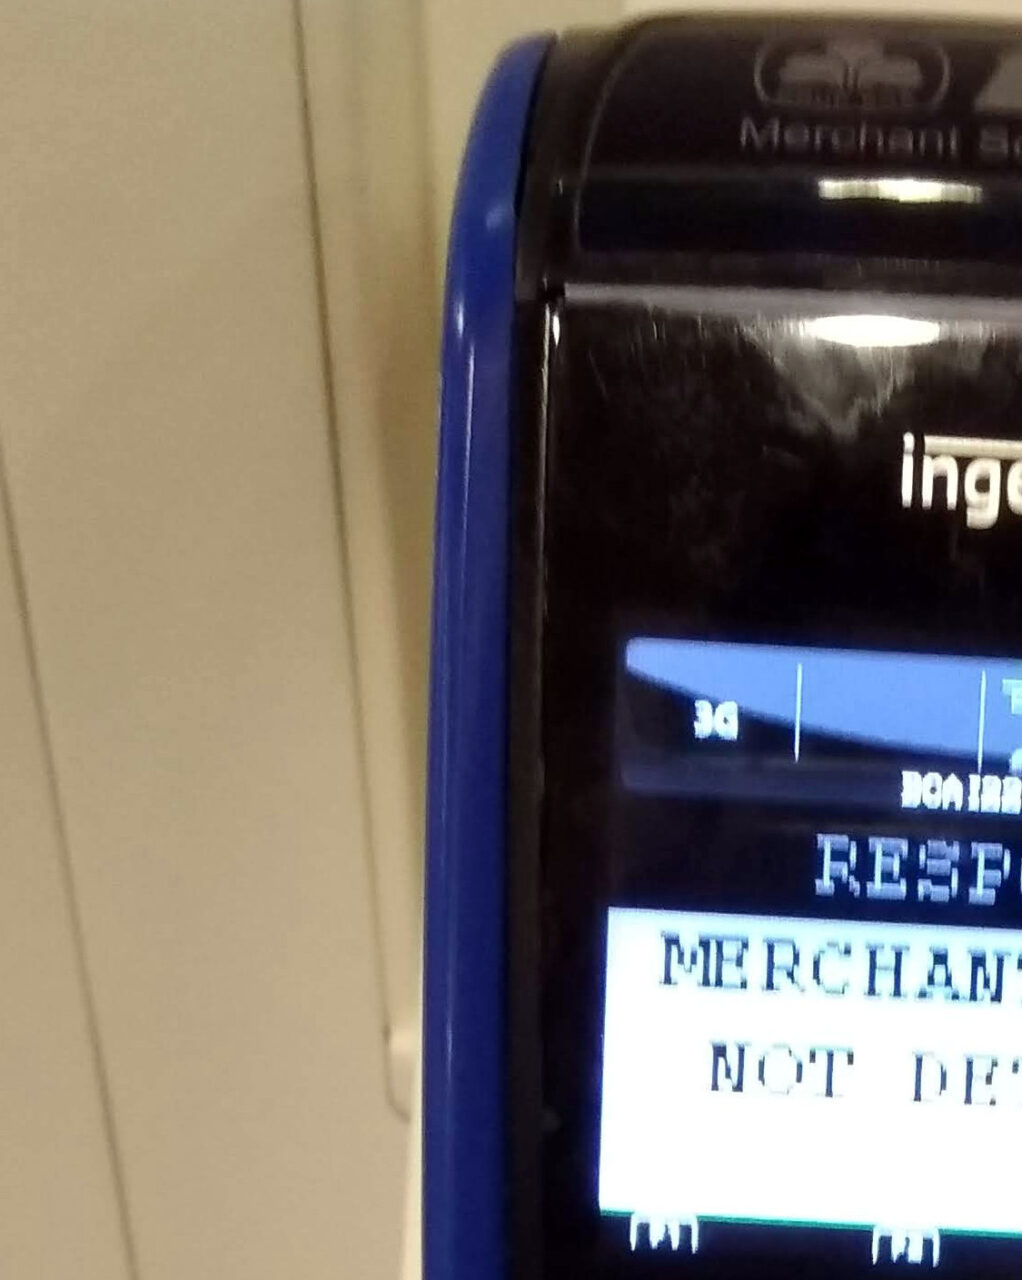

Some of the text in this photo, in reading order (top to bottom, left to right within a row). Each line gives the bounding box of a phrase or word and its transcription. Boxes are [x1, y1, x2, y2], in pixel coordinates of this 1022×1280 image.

[740, 116, 959, 156] Merchant
[694, 699, 738, 741] 3G
[709, 1039, 856, 1099] NOT
